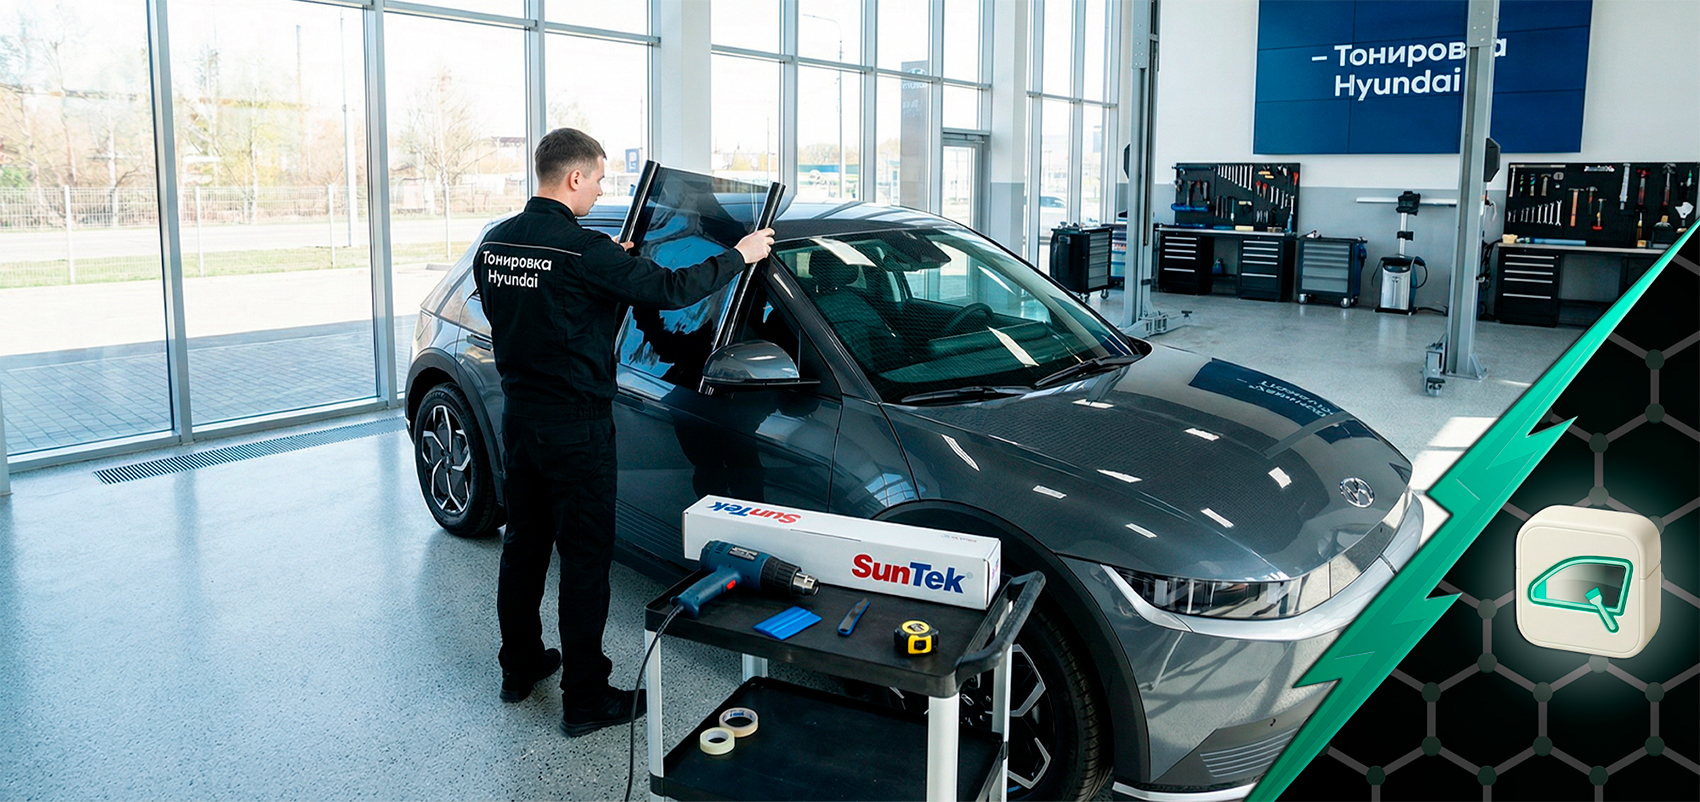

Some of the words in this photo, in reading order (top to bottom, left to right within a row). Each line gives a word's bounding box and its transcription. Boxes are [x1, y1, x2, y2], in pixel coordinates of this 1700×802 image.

[1333, 37, 1507, 67] Тонирова
[1334, 67, 1461, 101] Hyundai
[482, 250, 552, 271] Тонировка
[488, 269, 538, 288] Hyundai
[706, 501, 802, 524] SunTek
[851, 553, 965, 594] SunTek
